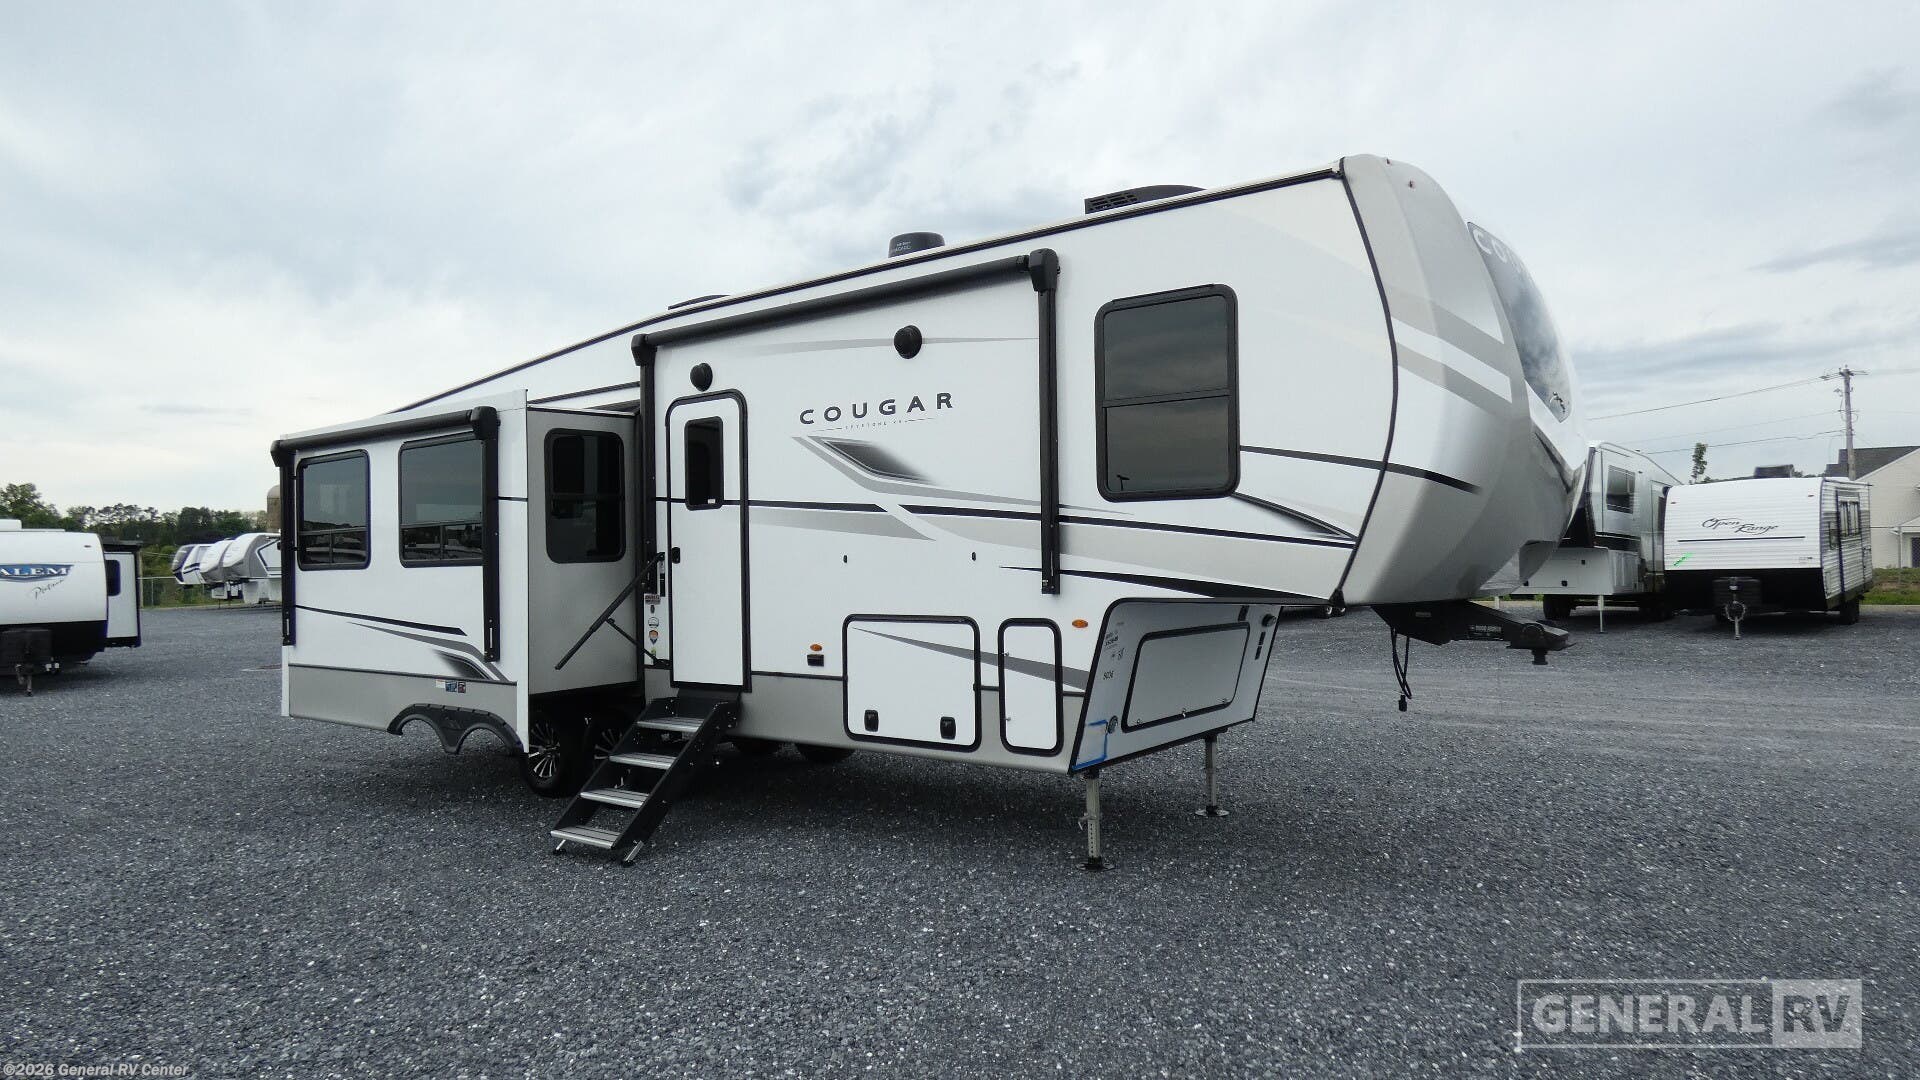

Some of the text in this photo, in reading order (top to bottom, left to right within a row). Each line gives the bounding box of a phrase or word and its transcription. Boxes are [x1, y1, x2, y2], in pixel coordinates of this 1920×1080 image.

[799, 392, 953, 425] COUGAR
[1702, 517, 1779, 536] Open Range
